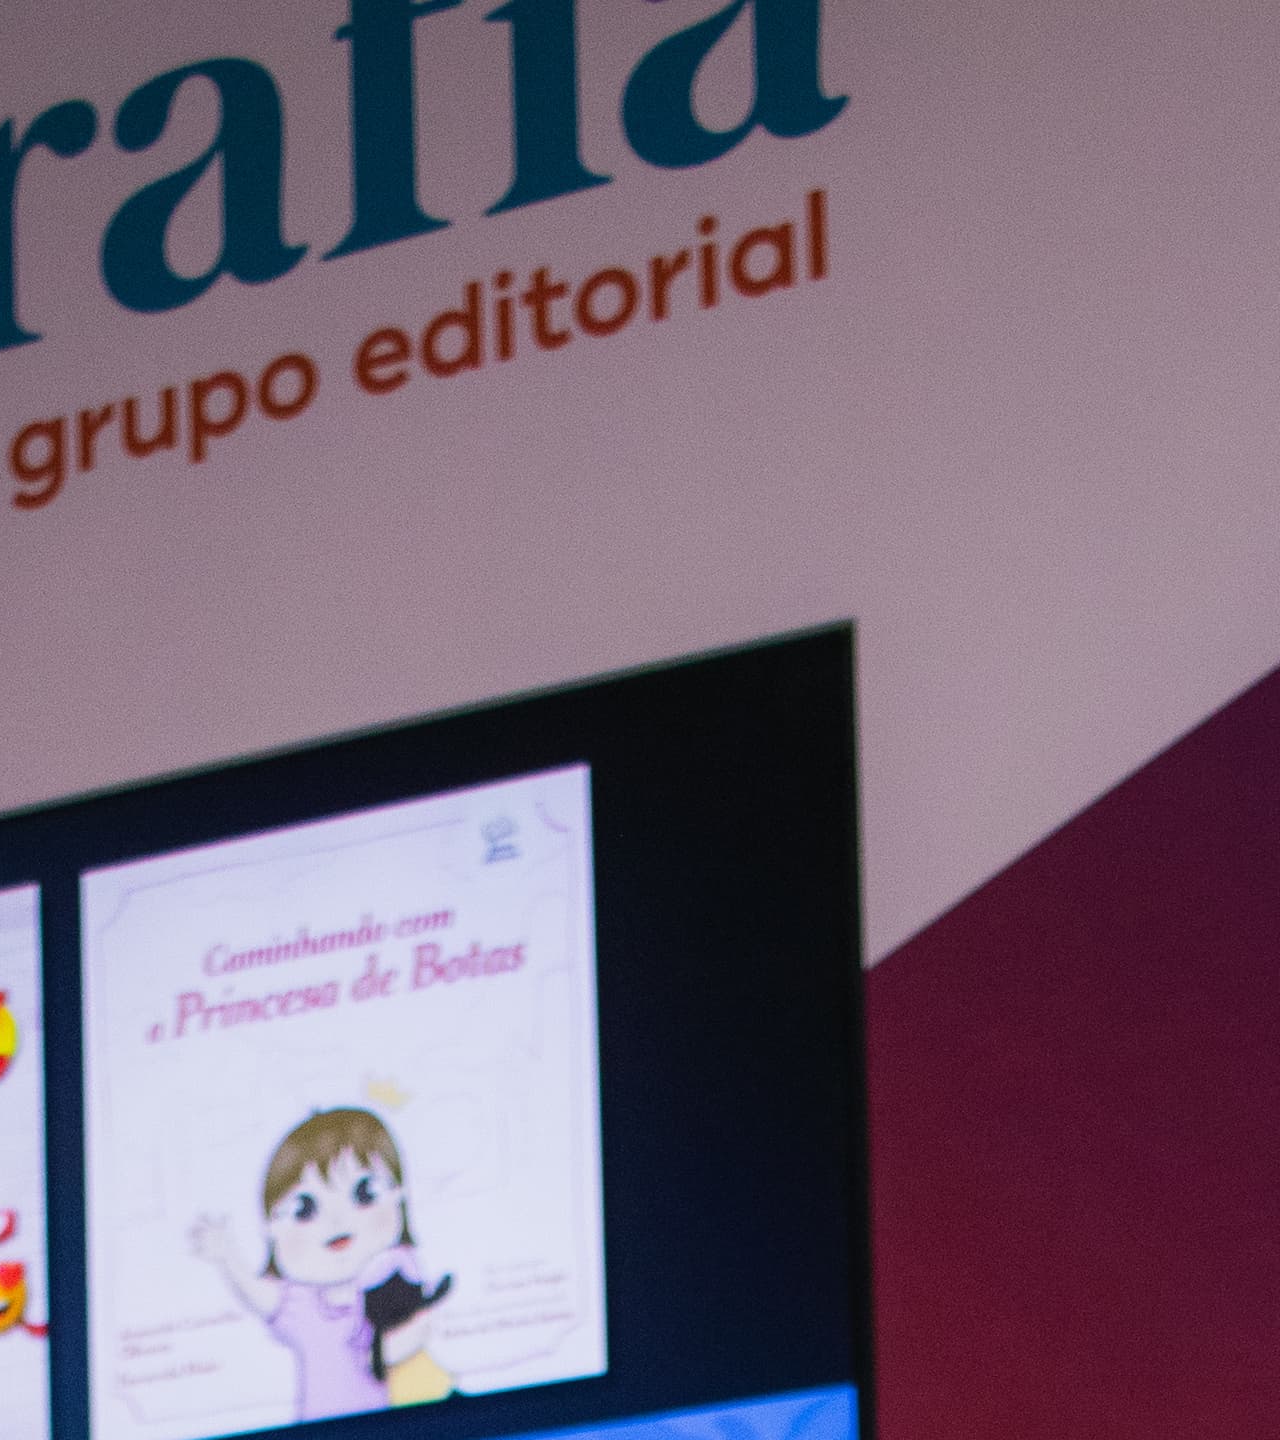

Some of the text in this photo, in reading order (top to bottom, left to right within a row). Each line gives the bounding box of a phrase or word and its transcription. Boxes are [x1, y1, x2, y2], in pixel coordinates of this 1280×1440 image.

[7, 189, 830, 510] grupo editorial
[172, 978, 339, 1041] Princesa
[350, 954, 401, 1002] de
[410, 938, 529, 992] Botas
[202, 906, 455, 977] Caminhando com
